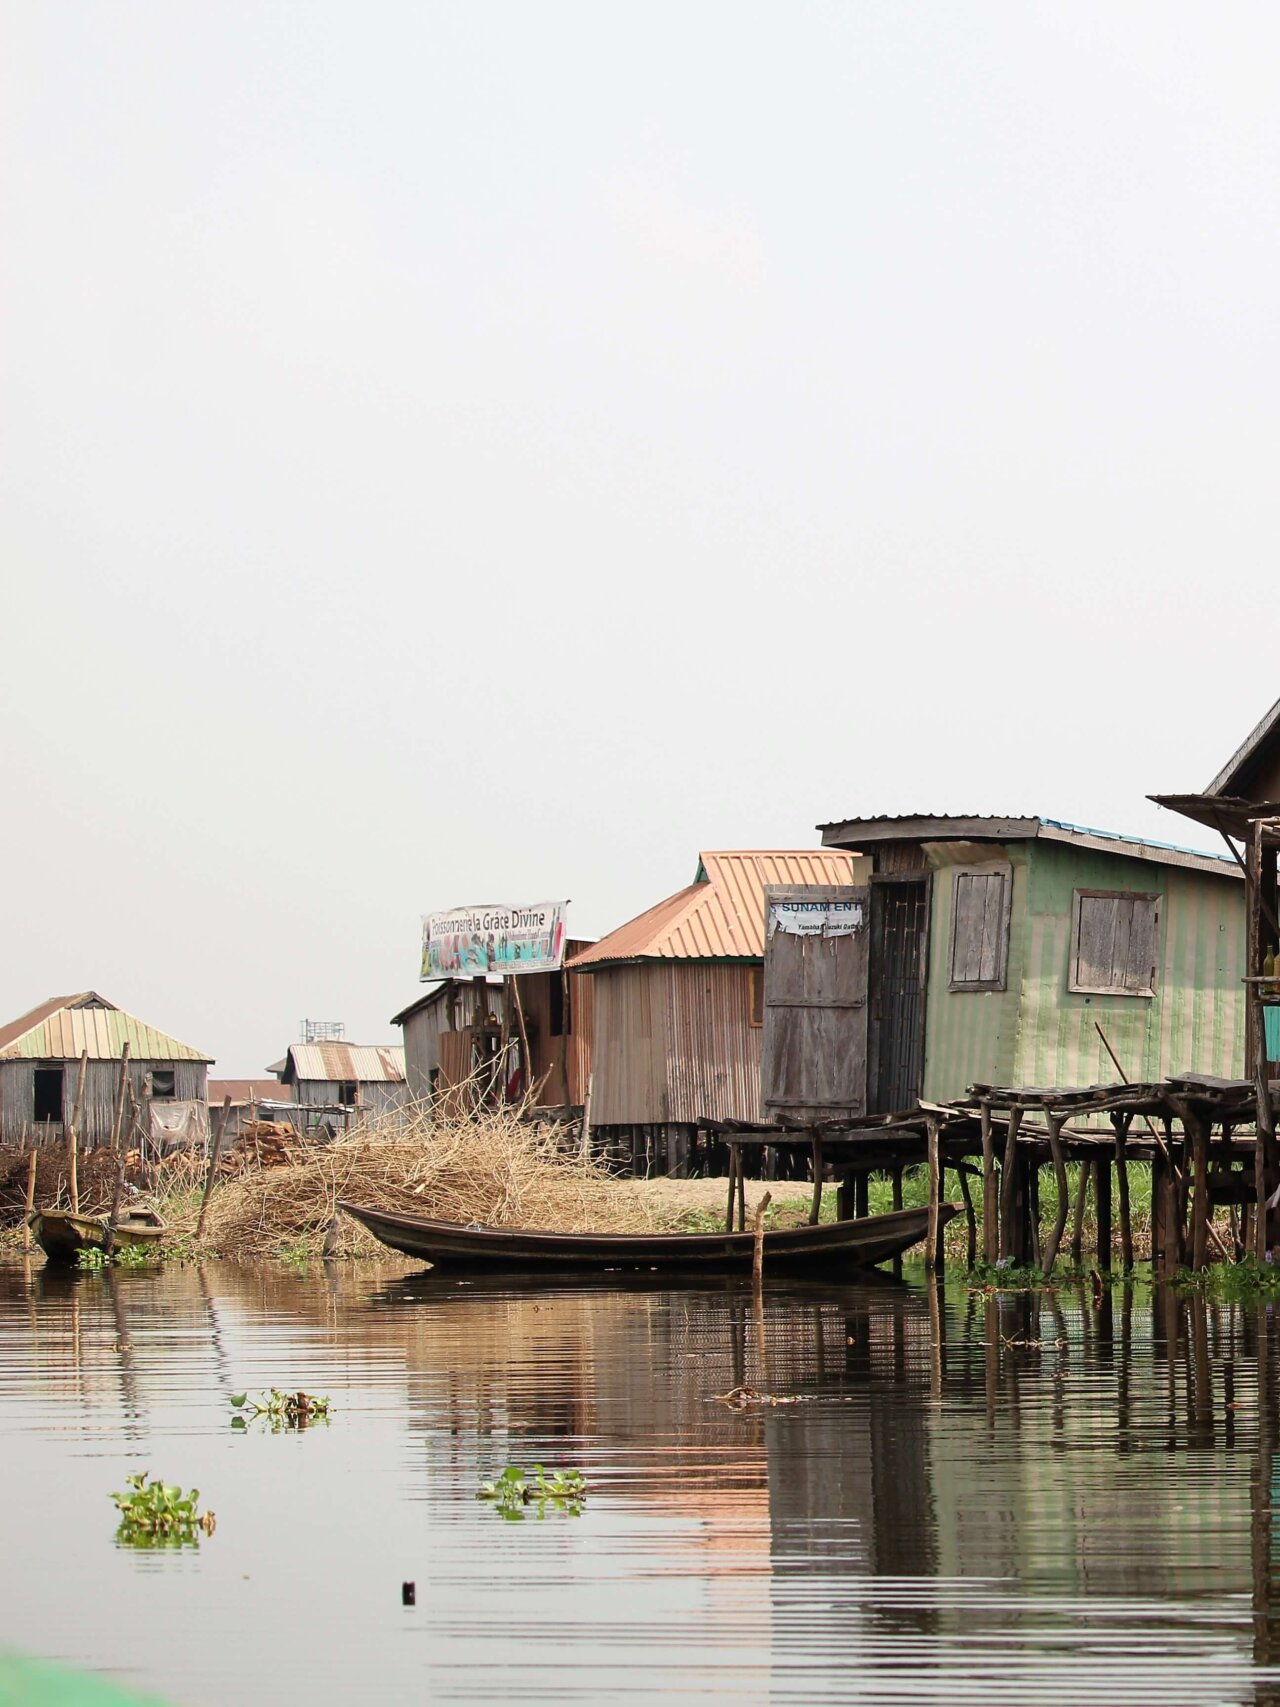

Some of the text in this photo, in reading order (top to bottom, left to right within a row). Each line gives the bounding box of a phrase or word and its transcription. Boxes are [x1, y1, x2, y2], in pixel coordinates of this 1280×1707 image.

[473, 913, 481, 931] la
[483, 911, 509, 930] Grâce
[511, 909, 545, 928] Divine
